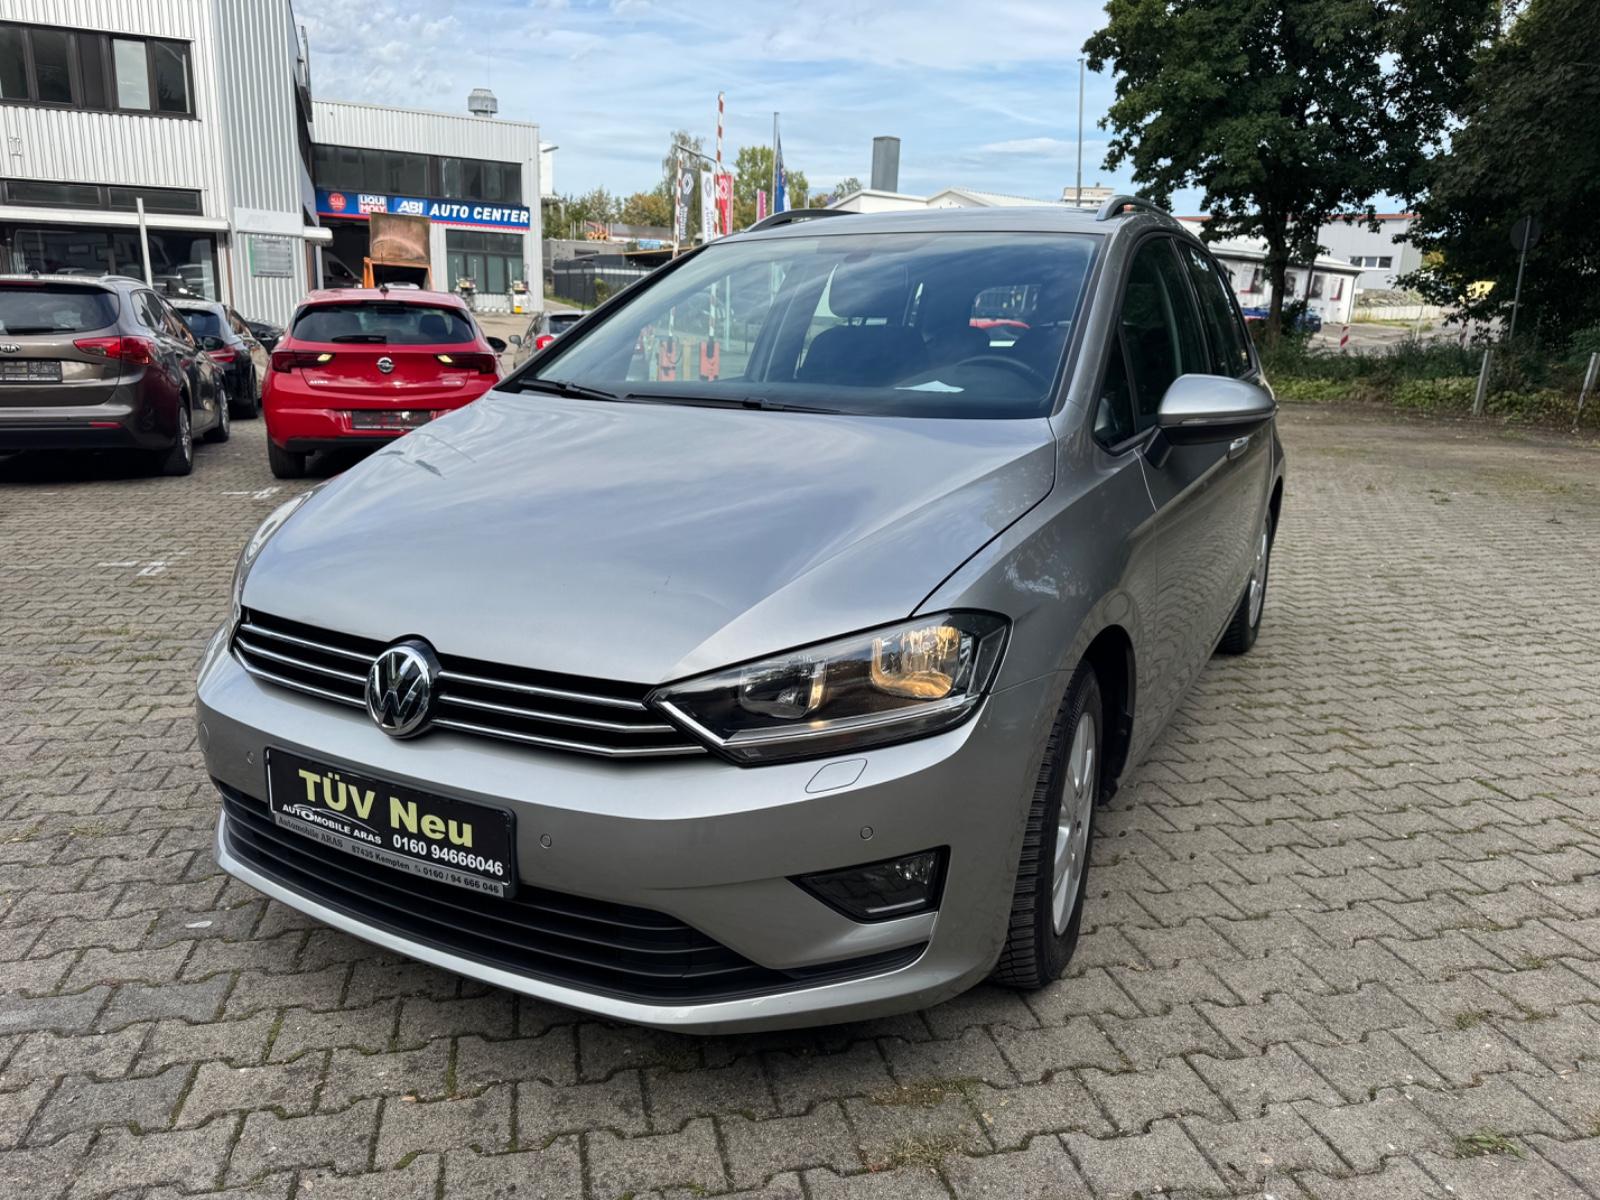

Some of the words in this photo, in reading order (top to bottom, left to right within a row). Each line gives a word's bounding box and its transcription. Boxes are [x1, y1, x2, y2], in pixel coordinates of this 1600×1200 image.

[360, 194, 385, 204] LIQUI
[360, 204, 385, 213] MOLY
[396, 200, 424, 214] ABI
[429, 203, 469, 218] AUTO
[473, 206, 530, 224] CENTER
[282, 803, 351, 835] AUTOMOBILE
[353, 829, 382, 844] ARAS
[298, 768, 376, 820] TÜV
[389, 796, 473, 848] Neu
[278, 815, 319, 839] Automobile
[321, 832, 343, 848] ARAS
[374, 851, 410, 870] Kempten
[423, 867, 443, 880] 0160
[450, 873, 462, 884] 94
[393, 834, 427, 855] 0160
[431, 845, 504, 876] 94666046
